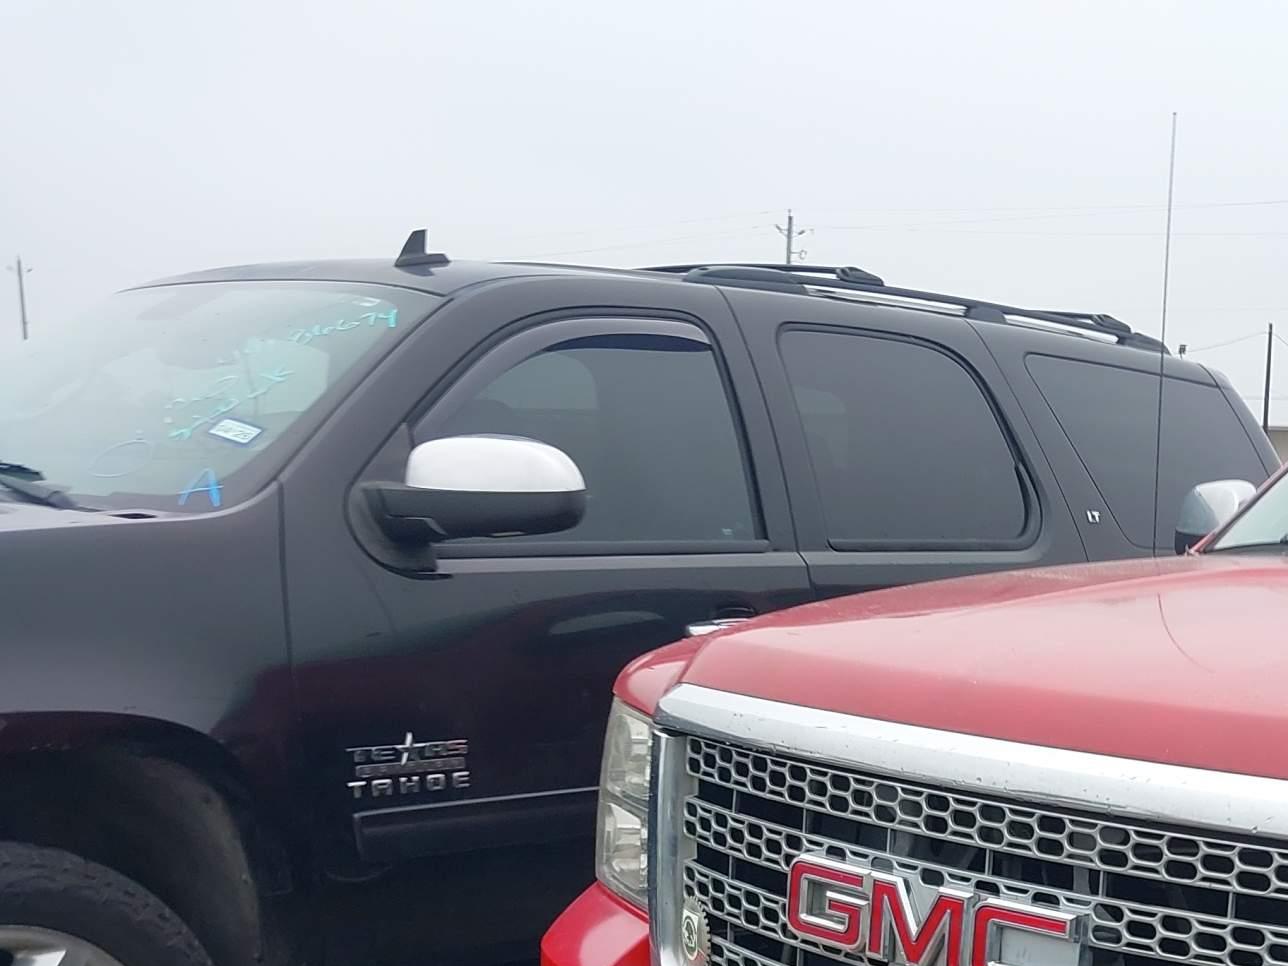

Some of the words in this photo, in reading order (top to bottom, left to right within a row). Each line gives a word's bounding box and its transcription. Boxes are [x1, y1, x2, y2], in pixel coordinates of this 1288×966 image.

[177, 468, 224, 507] A
[1086, 510, 1100, 523] LT
[346, 771, 470, 798] TAHOE
